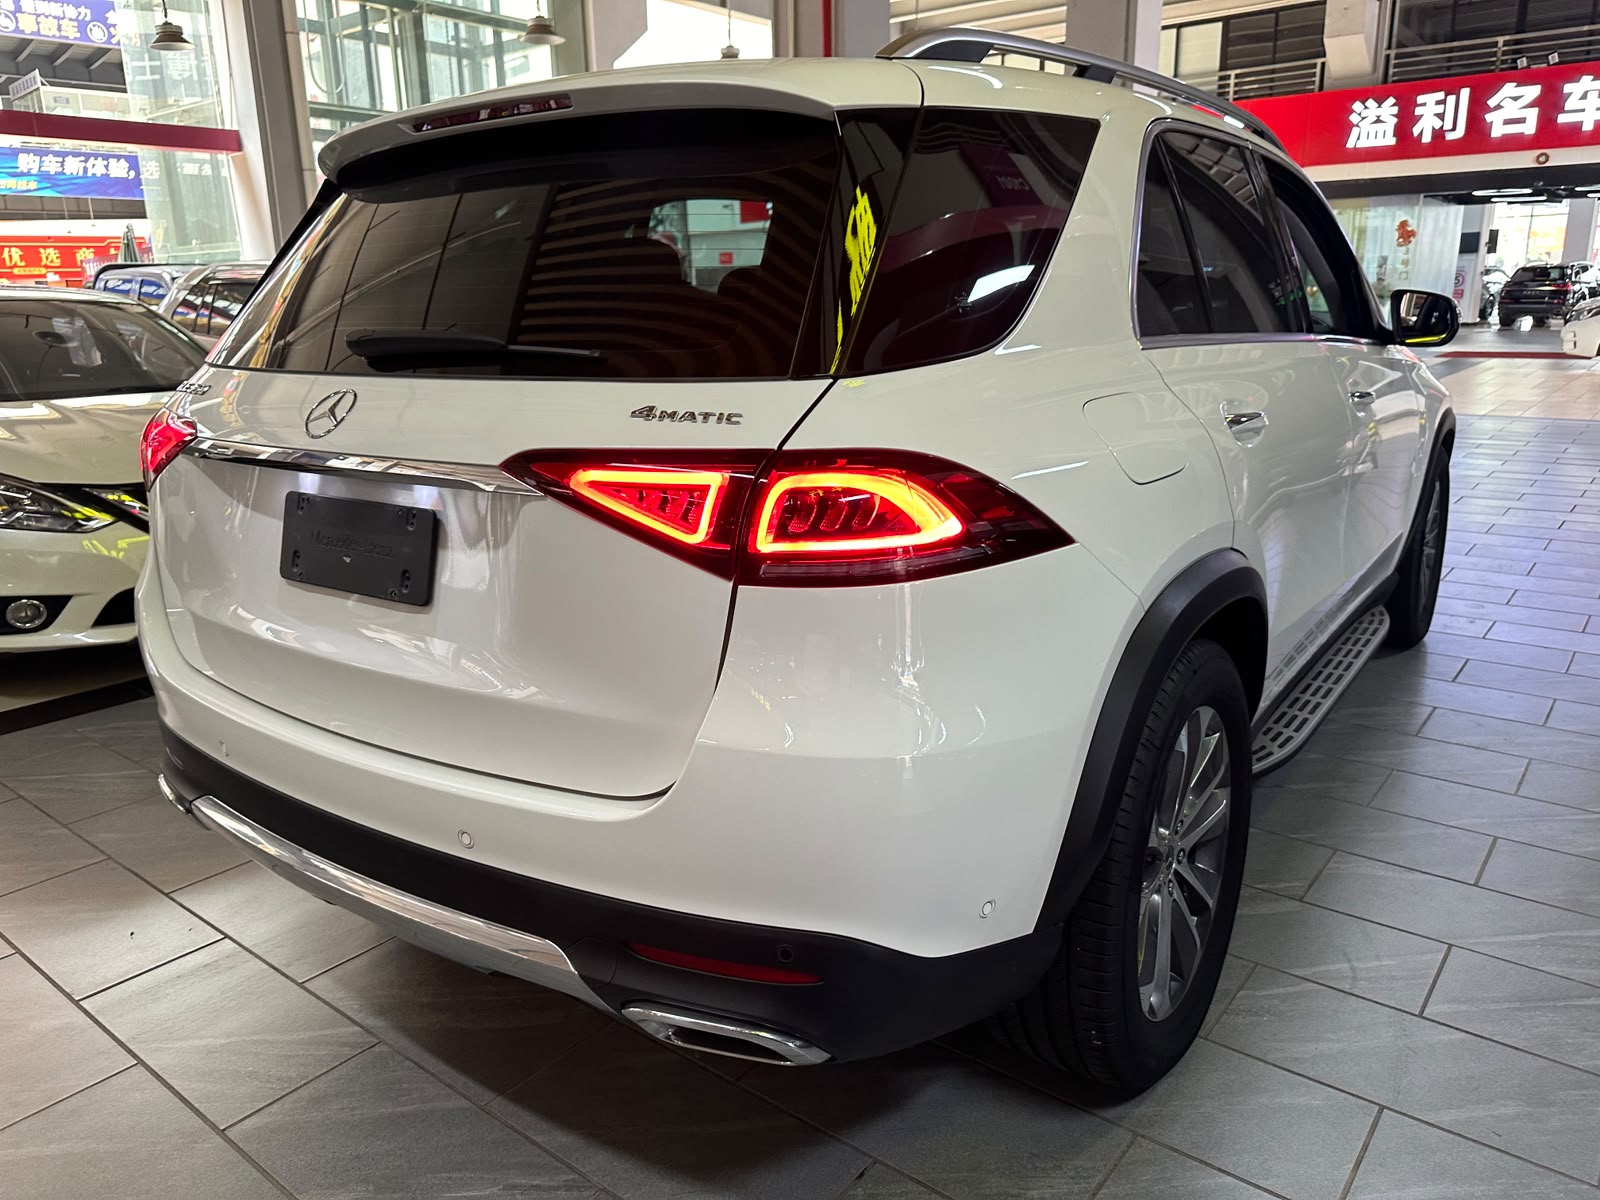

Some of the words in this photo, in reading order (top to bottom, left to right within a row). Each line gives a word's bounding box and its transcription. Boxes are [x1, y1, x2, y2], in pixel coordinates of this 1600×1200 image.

[16, 13, 81, 39] 事故车
[1345, 75, 1600, 149] 溢利名车
[629, 404, 744, 426] 4MATIC
